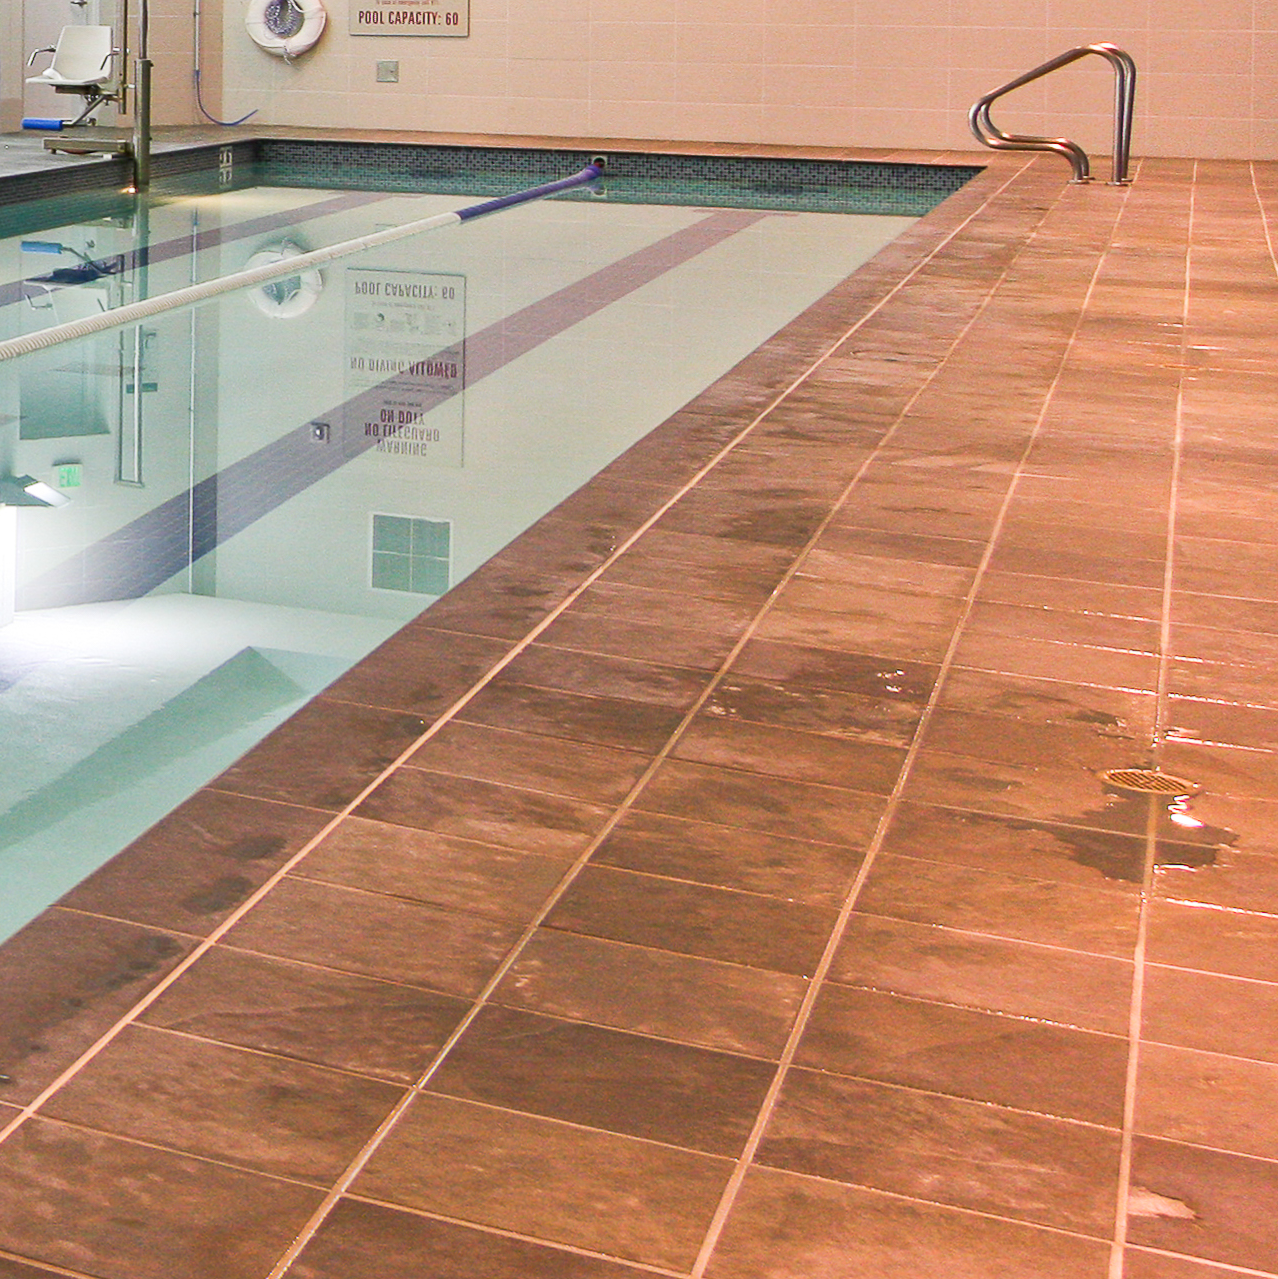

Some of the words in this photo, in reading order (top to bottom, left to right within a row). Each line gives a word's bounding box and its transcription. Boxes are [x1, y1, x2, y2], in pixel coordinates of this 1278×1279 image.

[359, 10, 385, 24] POOL
[389, 10, 441, 26] CAPACITY:
[446, 12, 459, 26] 60
